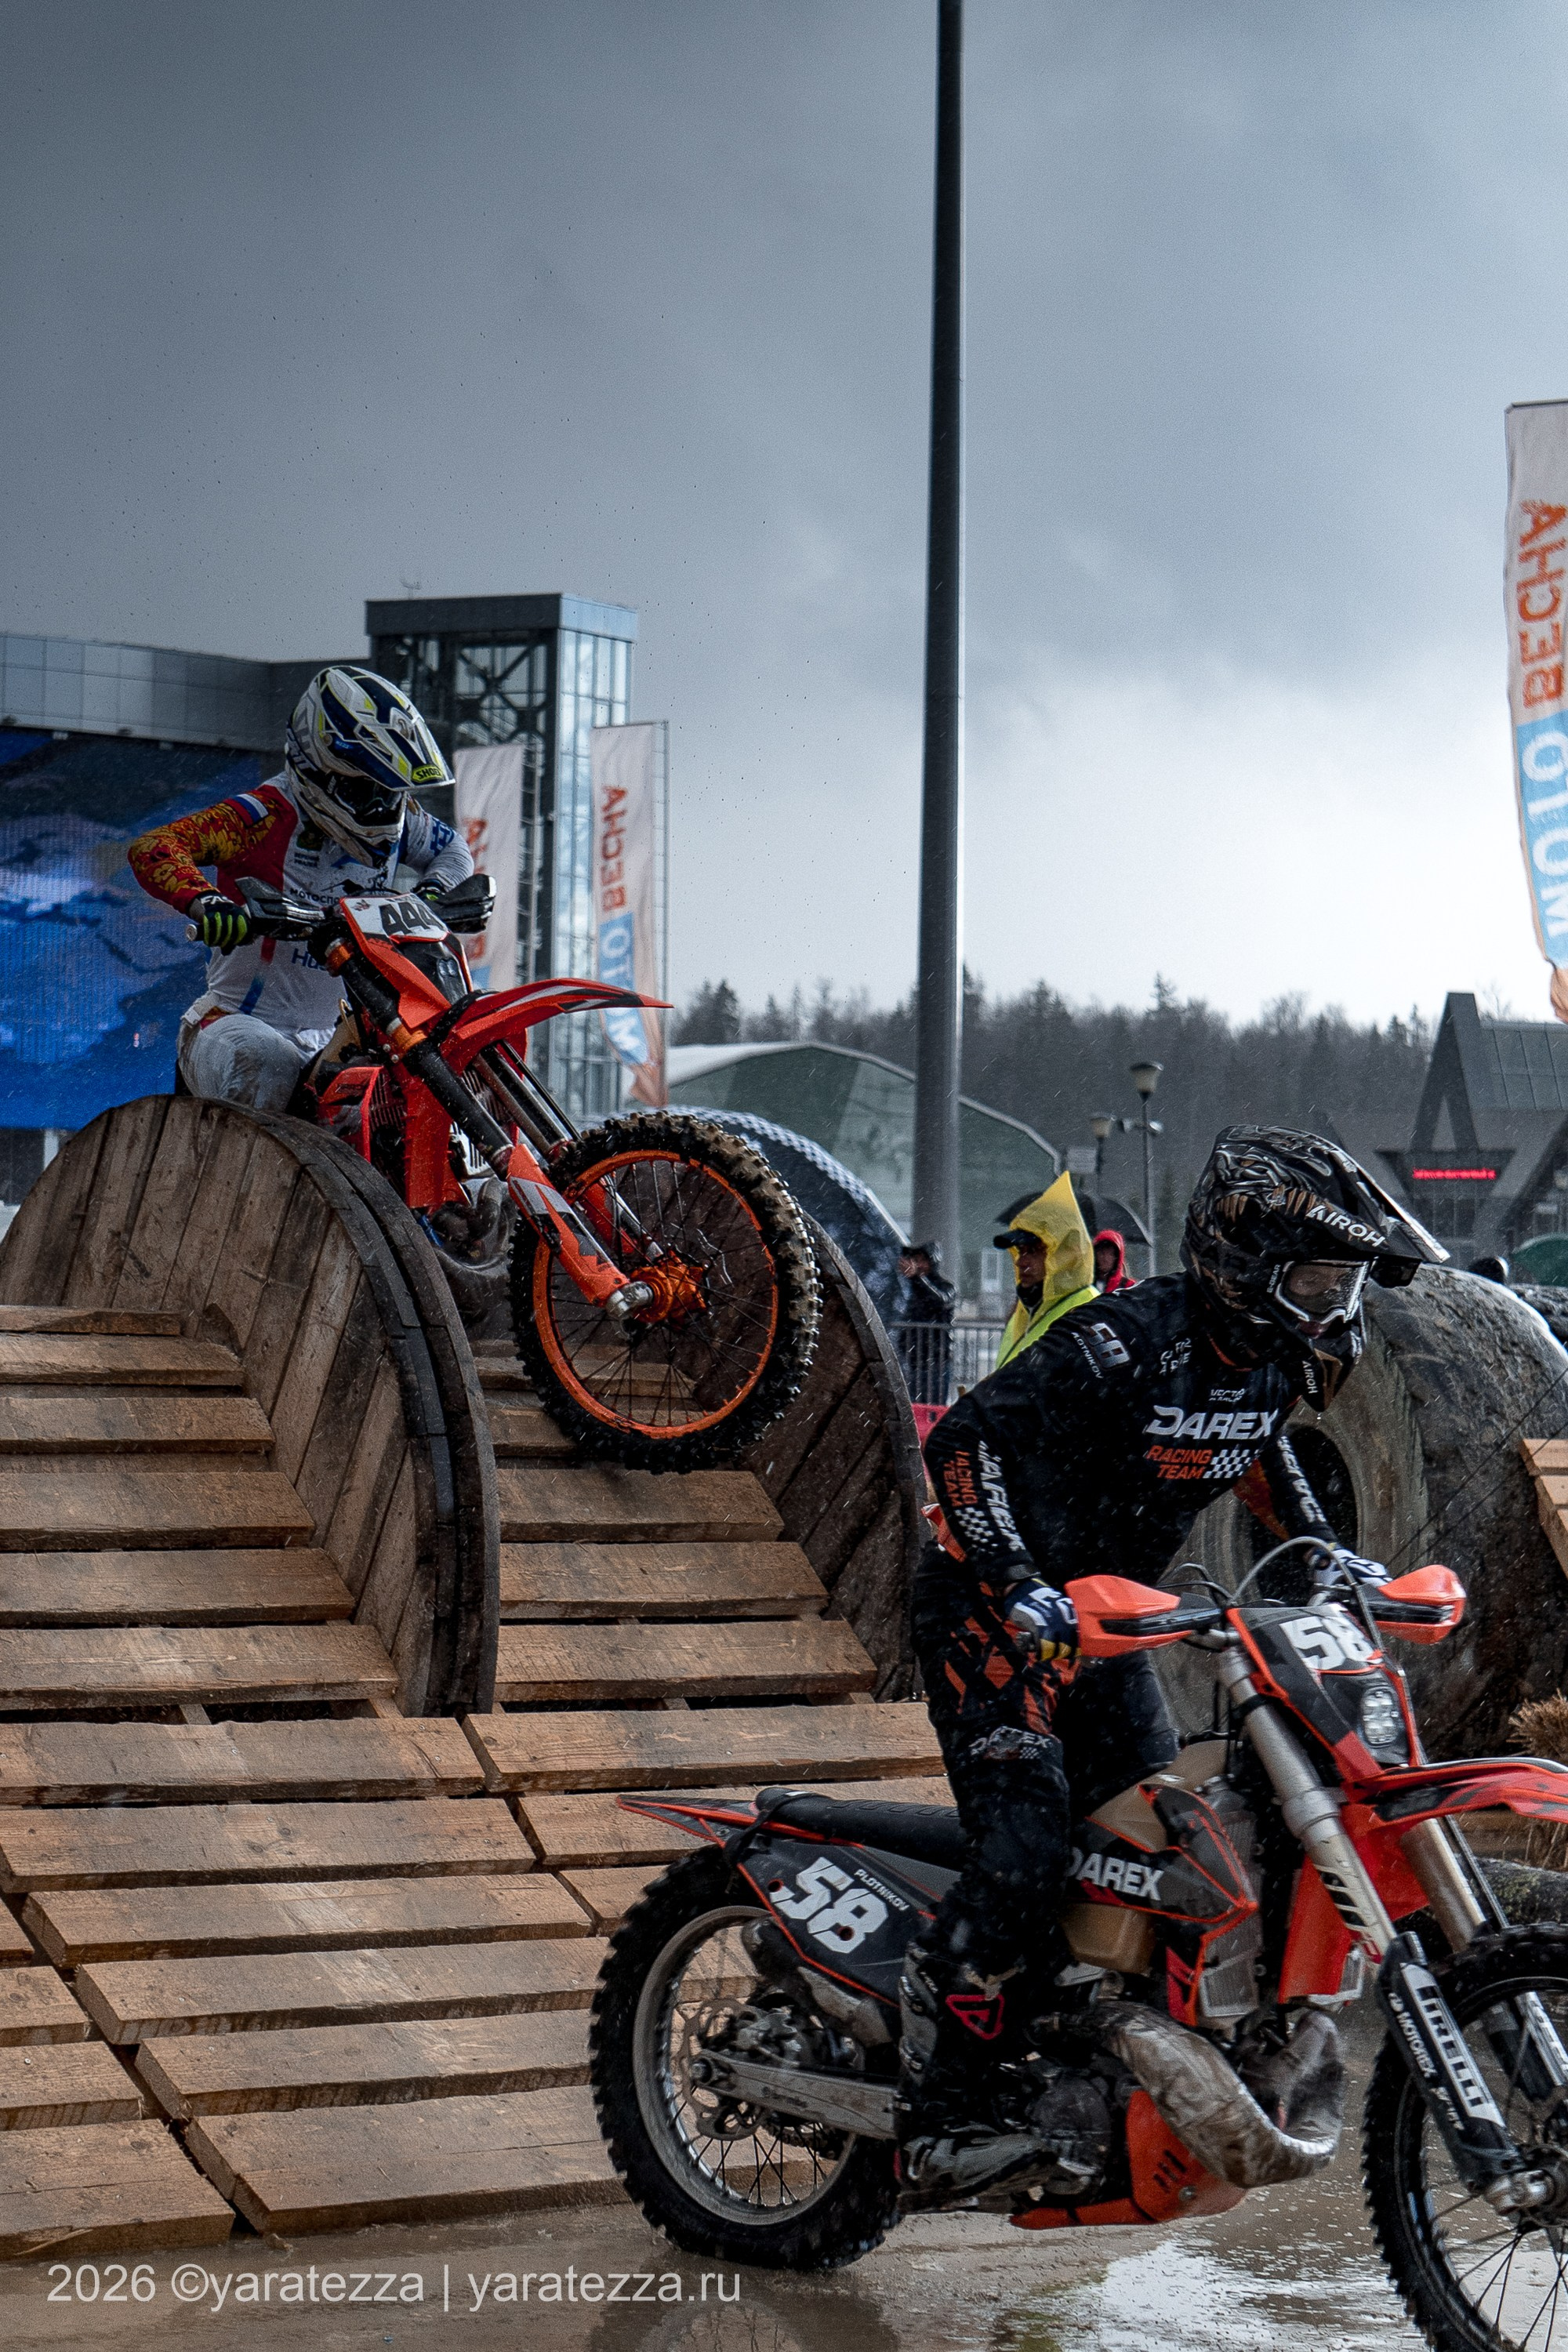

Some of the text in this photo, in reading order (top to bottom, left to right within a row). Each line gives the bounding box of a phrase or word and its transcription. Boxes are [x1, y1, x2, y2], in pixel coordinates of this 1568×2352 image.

[379, 902, 444, 935] 444
[1305, 1204, 1386, 1247] AIROH
[1089, 1323, 1130, 1369] 58
[1301, 1360, 1319, 1395] AIROH
[1145, 1405, 1279, 1439] DAREX
[1146, 1445, 1213, 1465] RACING
[1157, 1465, 1207, 1479] TEAM
[1279, 1616, 1383, 1670] 58
[769, 1857, 889, 1954] 58
[854, 1868, 910, 1911] PLOTNIKOV
[1396, 2011, 1439, 2078] MOTOREX
